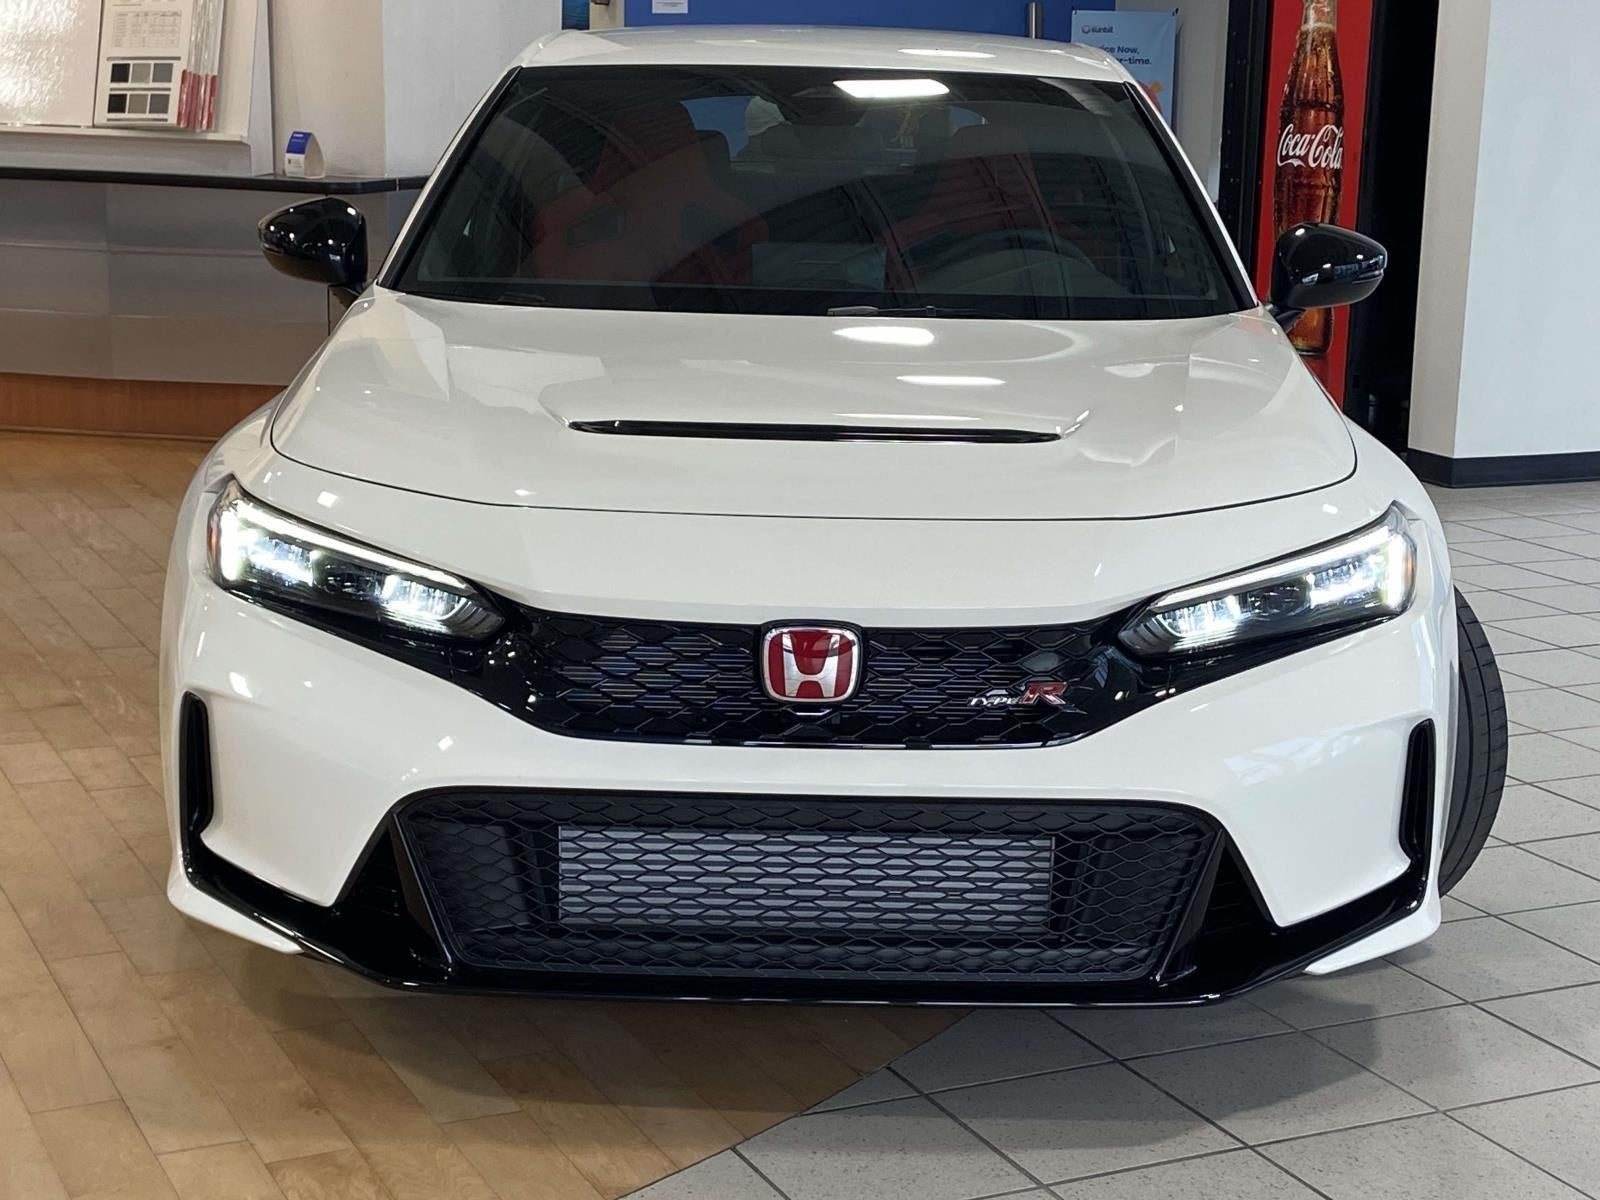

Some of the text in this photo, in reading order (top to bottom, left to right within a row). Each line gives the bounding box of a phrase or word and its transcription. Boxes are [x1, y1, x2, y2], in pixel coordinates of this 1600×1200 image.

[1117, 45, 1140, 55] Now,
[1276, 123, 1344, 170] Coca-Cola
[1018, 682, 1067, 705] R
